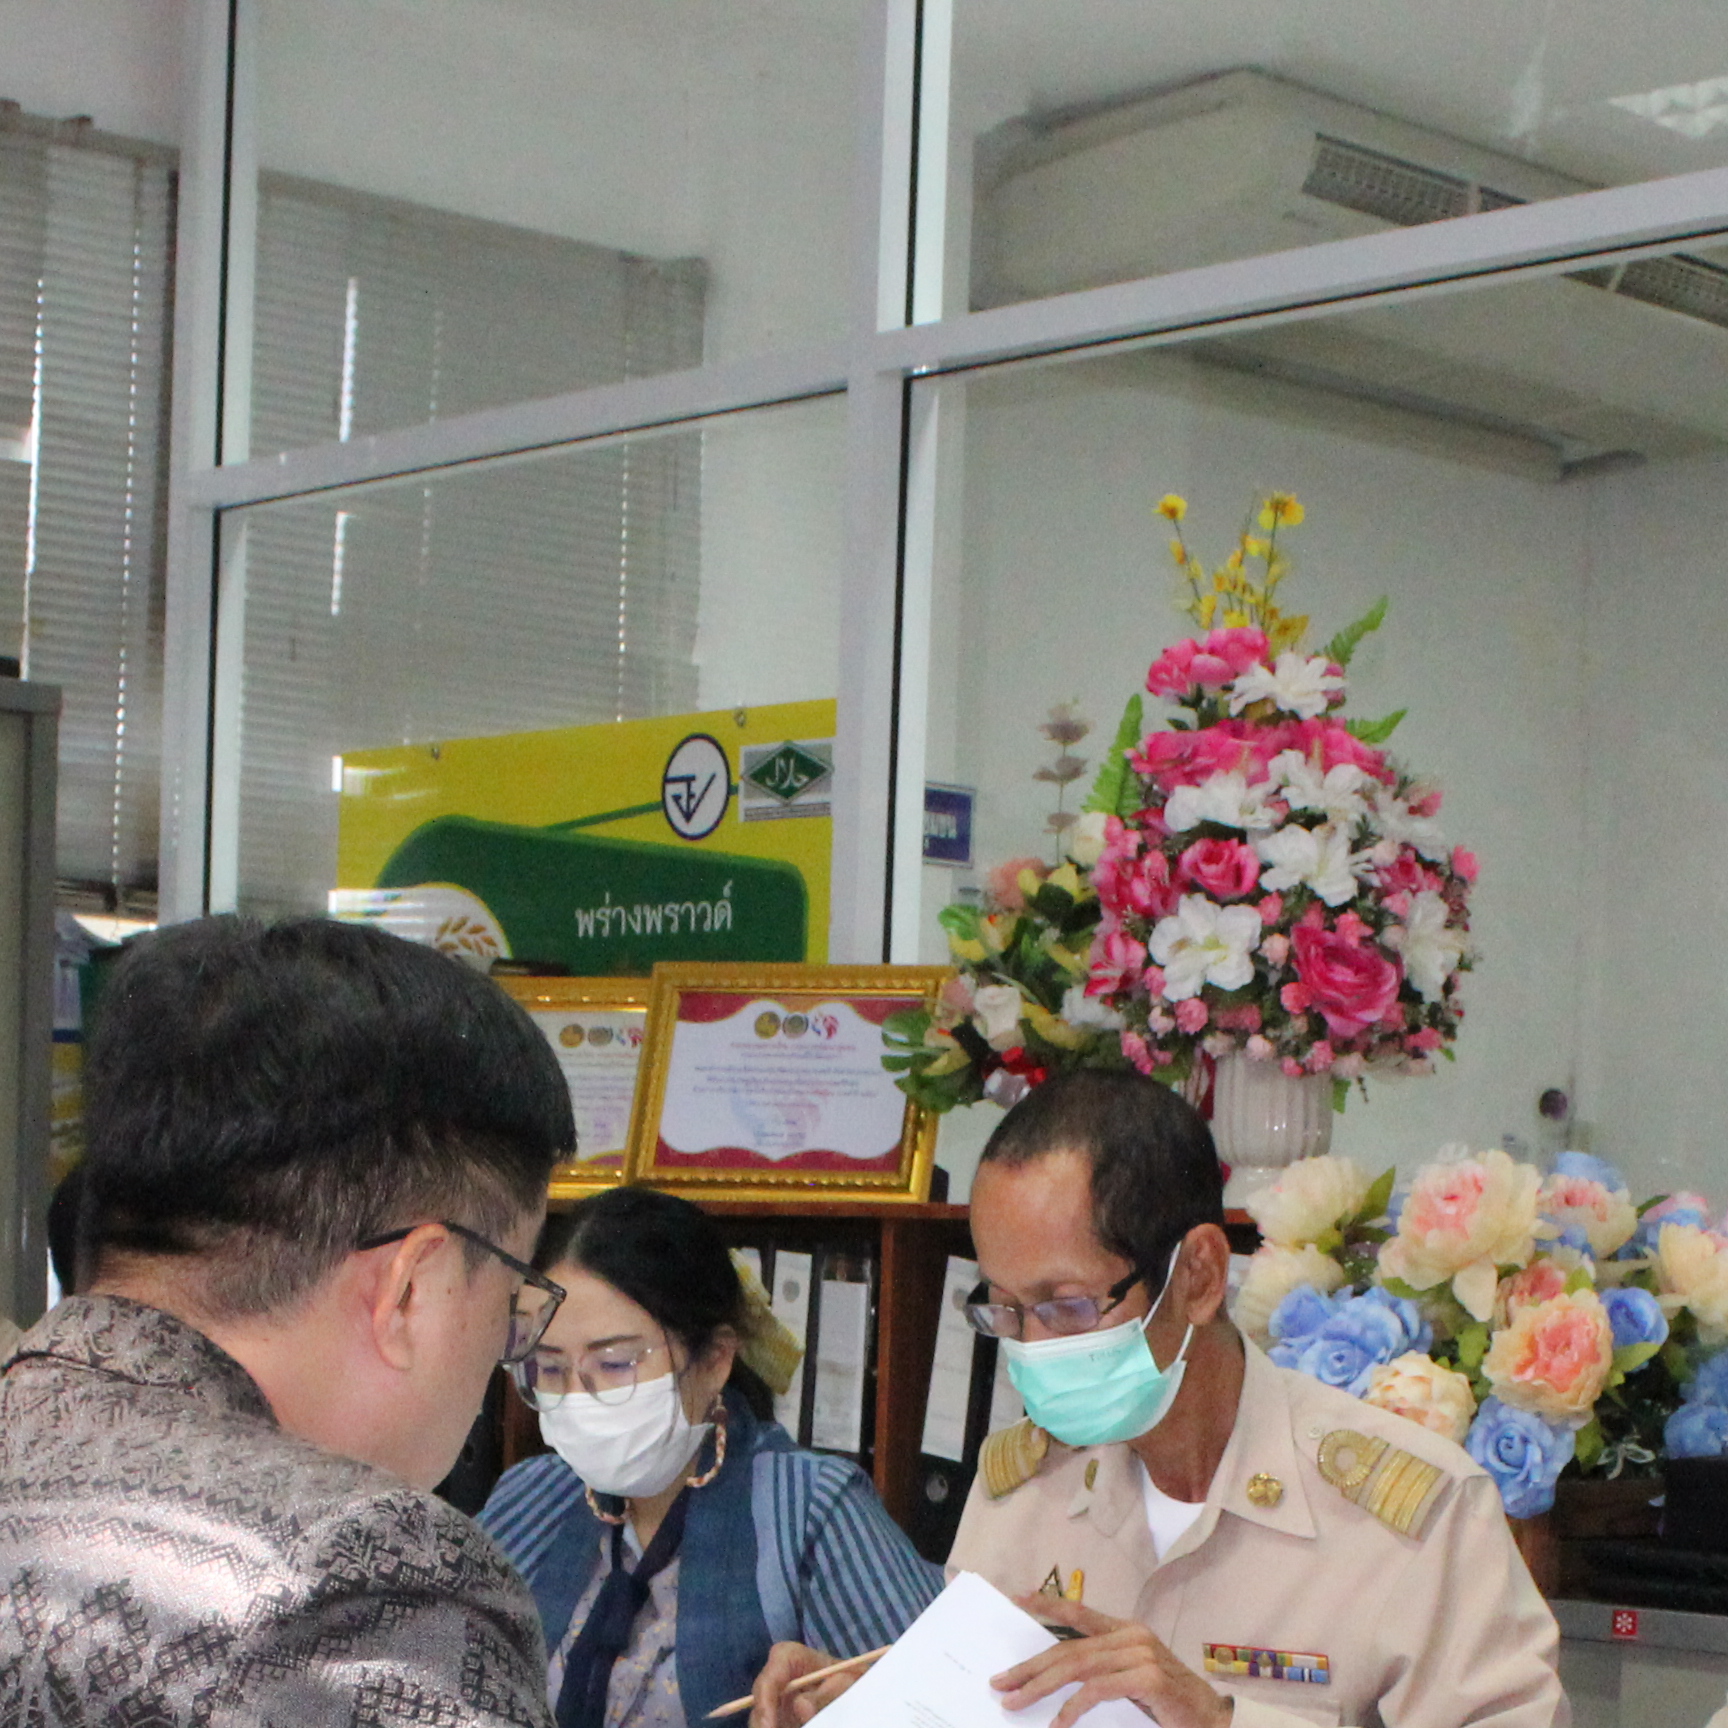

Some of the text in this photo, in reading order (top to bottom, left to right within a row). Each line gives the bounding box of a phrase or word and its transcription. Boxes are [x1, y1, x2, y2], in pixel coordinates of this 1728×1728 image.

[574, 879, 734, 938] พร่างพราวด์
